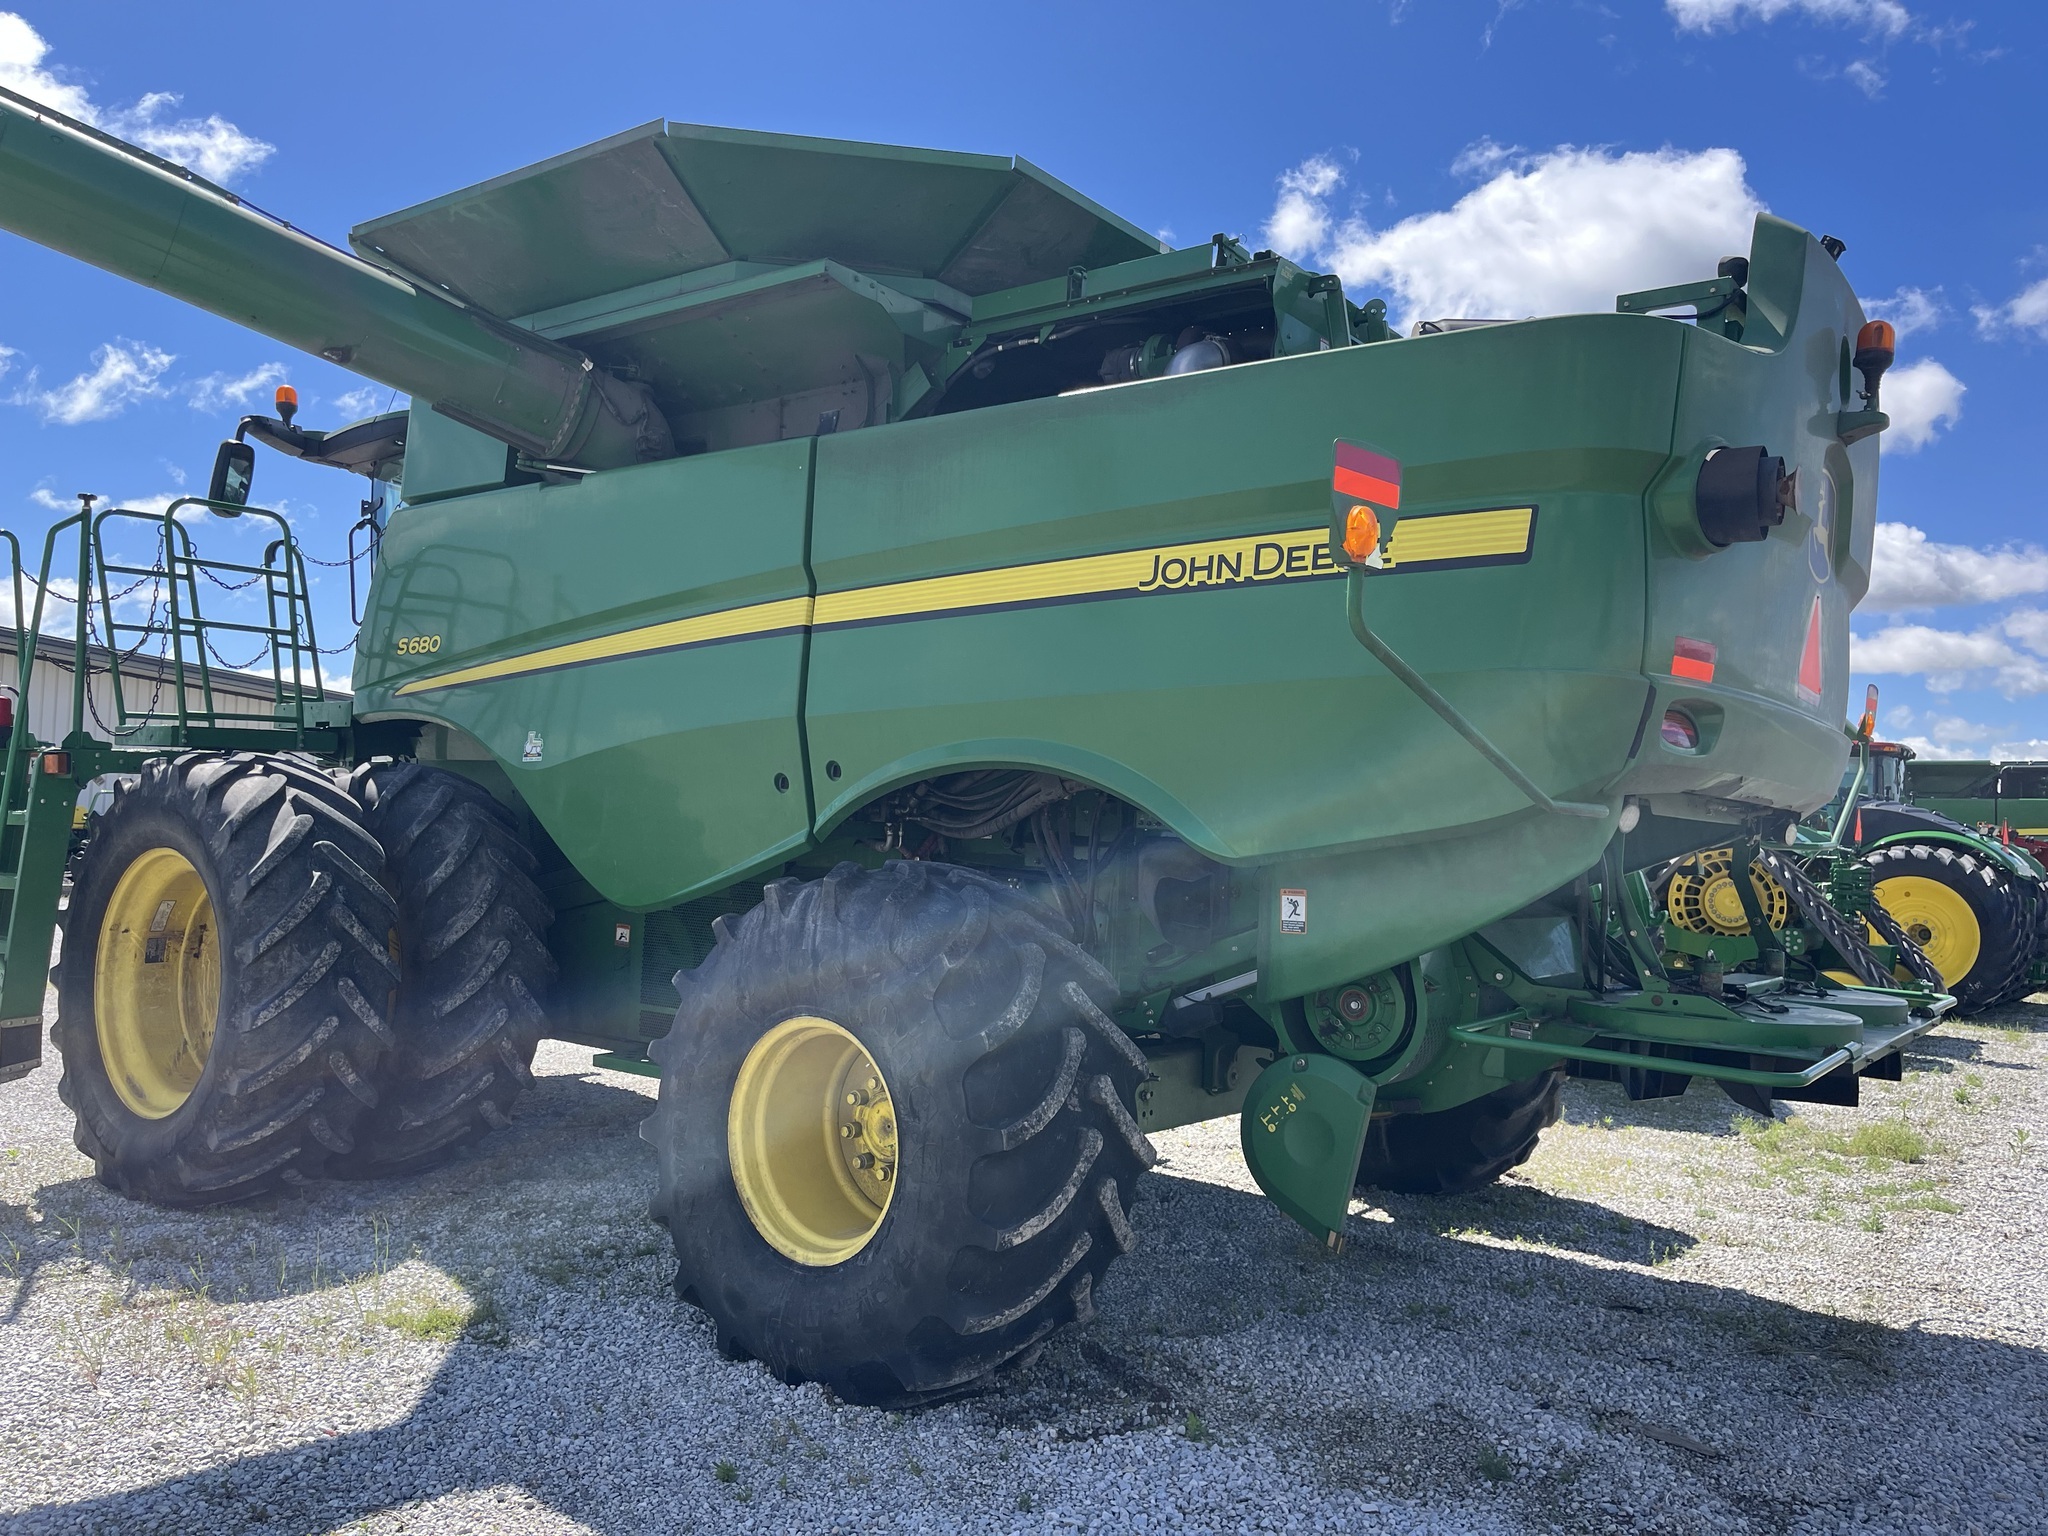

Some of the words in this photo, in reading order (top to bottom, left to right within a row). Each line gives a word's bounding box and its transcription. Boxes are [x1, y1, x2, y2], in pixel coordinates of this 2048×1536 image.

[1138, 551, 1243, 588] JOHN
[1253, 536, 1393, 577] DEE
[396, 634, 442, 657] S680
